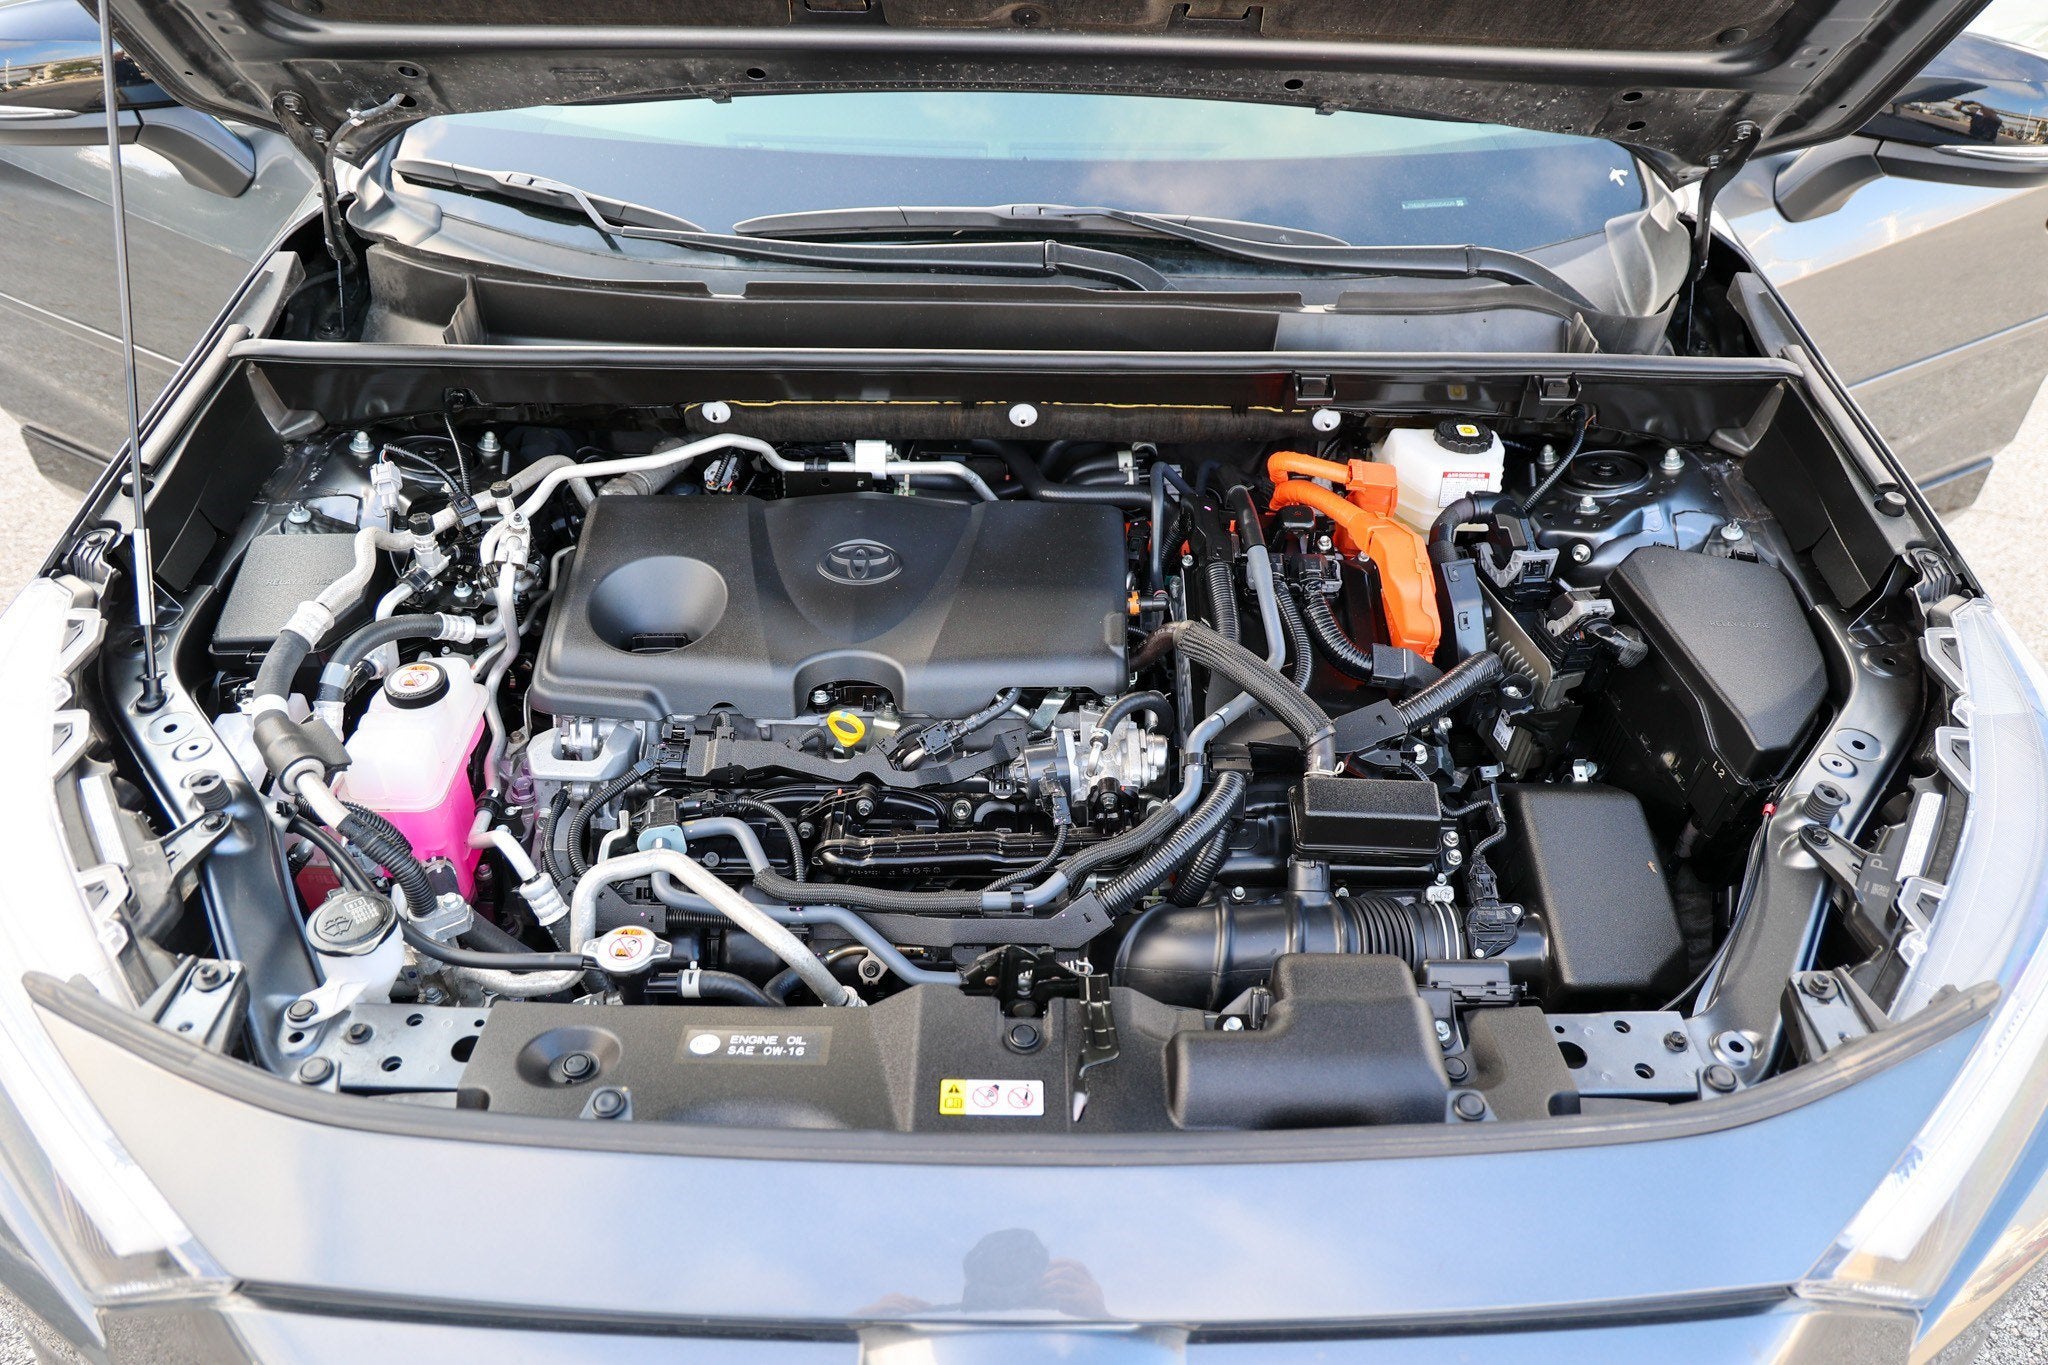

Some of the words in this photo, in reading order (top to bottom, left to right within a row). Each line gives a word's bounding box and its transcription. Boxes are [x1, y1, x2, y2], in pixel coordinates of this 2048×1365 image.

[1712, 760, 1725, 779] L2
[729, 1035, 779, 1045] ENGINE
[786, 1035, 807, 1046] OIL
[727, 1045, 756, 1055] SAE
[763, 1046, 805, 1057] 0W-16
